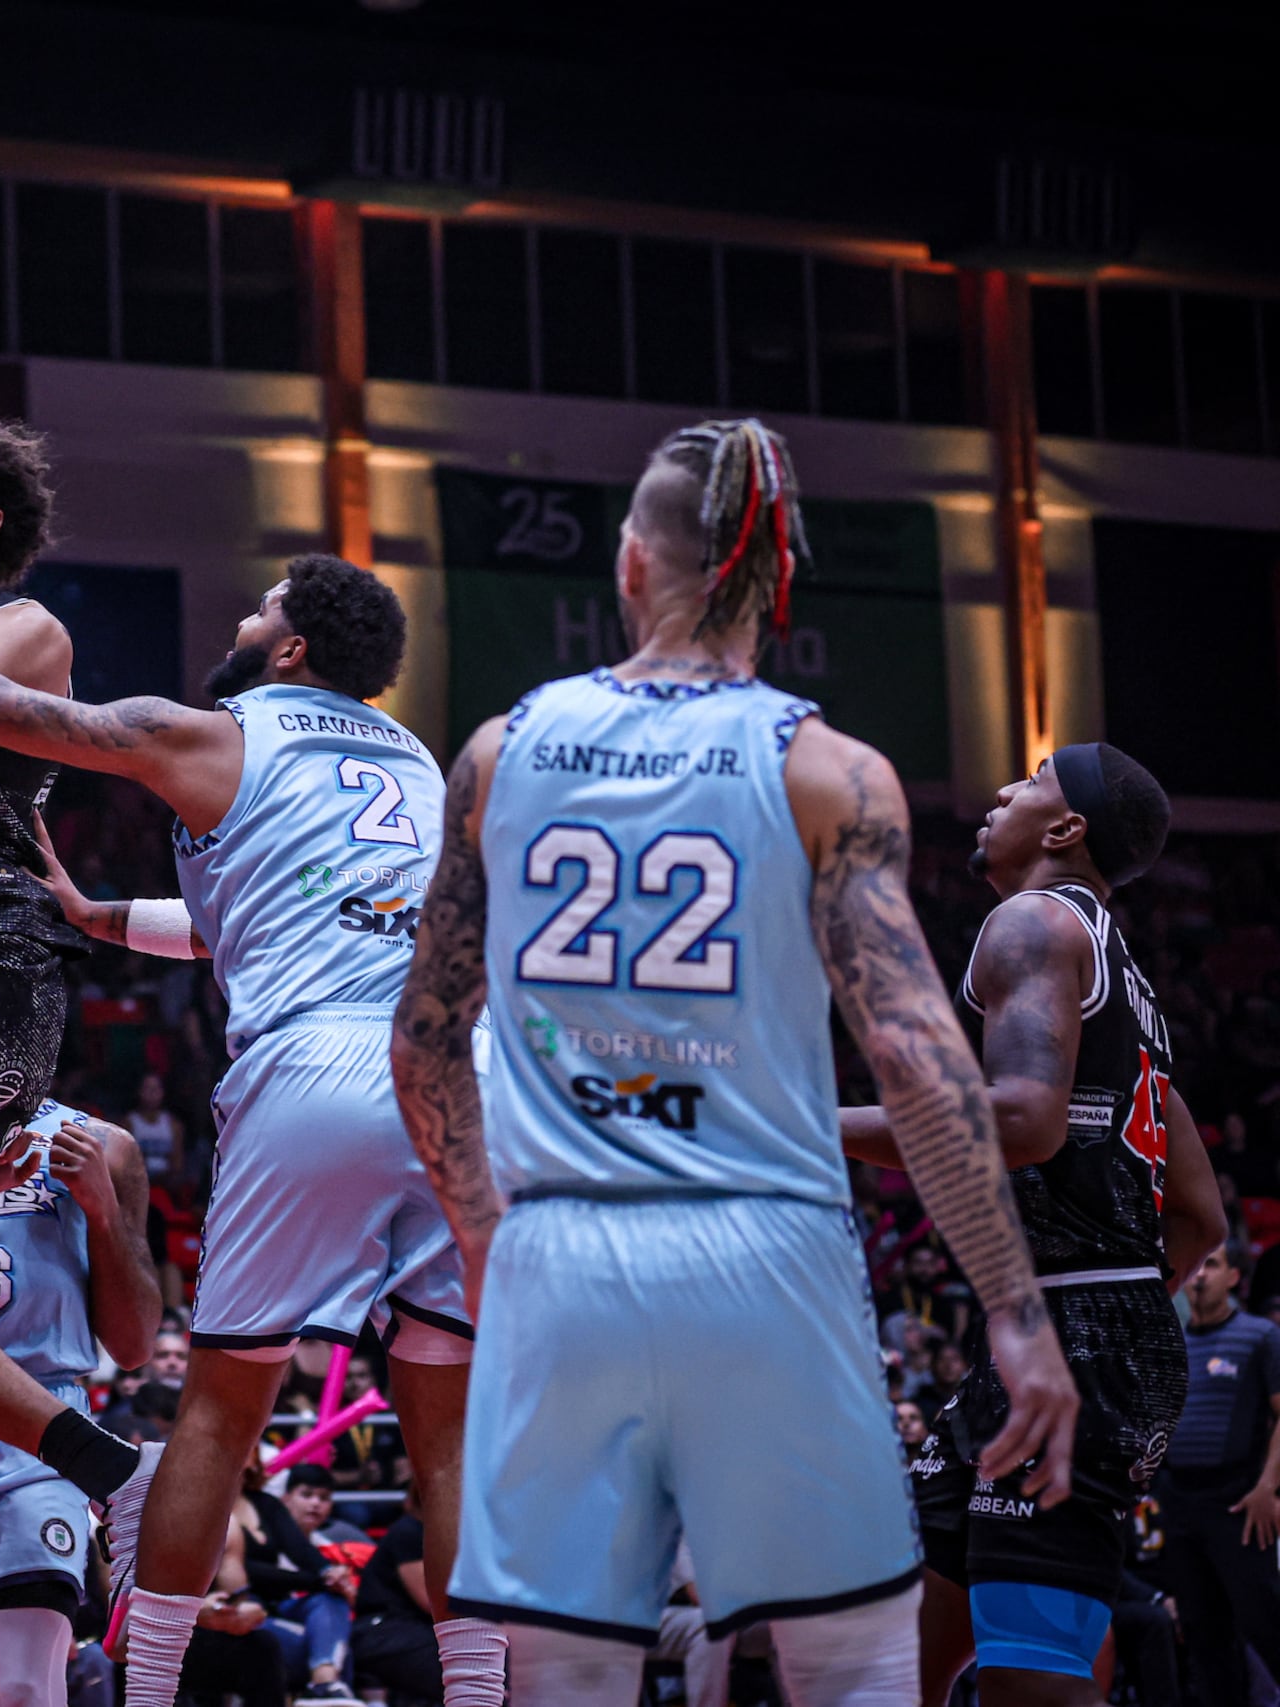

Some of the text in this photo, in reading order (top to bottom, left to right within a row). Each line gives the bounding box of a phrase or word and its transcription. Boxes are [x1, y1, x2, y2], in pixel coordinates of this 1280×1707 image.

[495, 484, 585, 561] 25
[277, 713, 422, 754] CRAWFORD
[695, 747, 747, 779] JR.
[336, 755, 421, 853] 2
[517, 821, 739, 996] 22
[566, 1027, 739, 1070] TORTLINK
